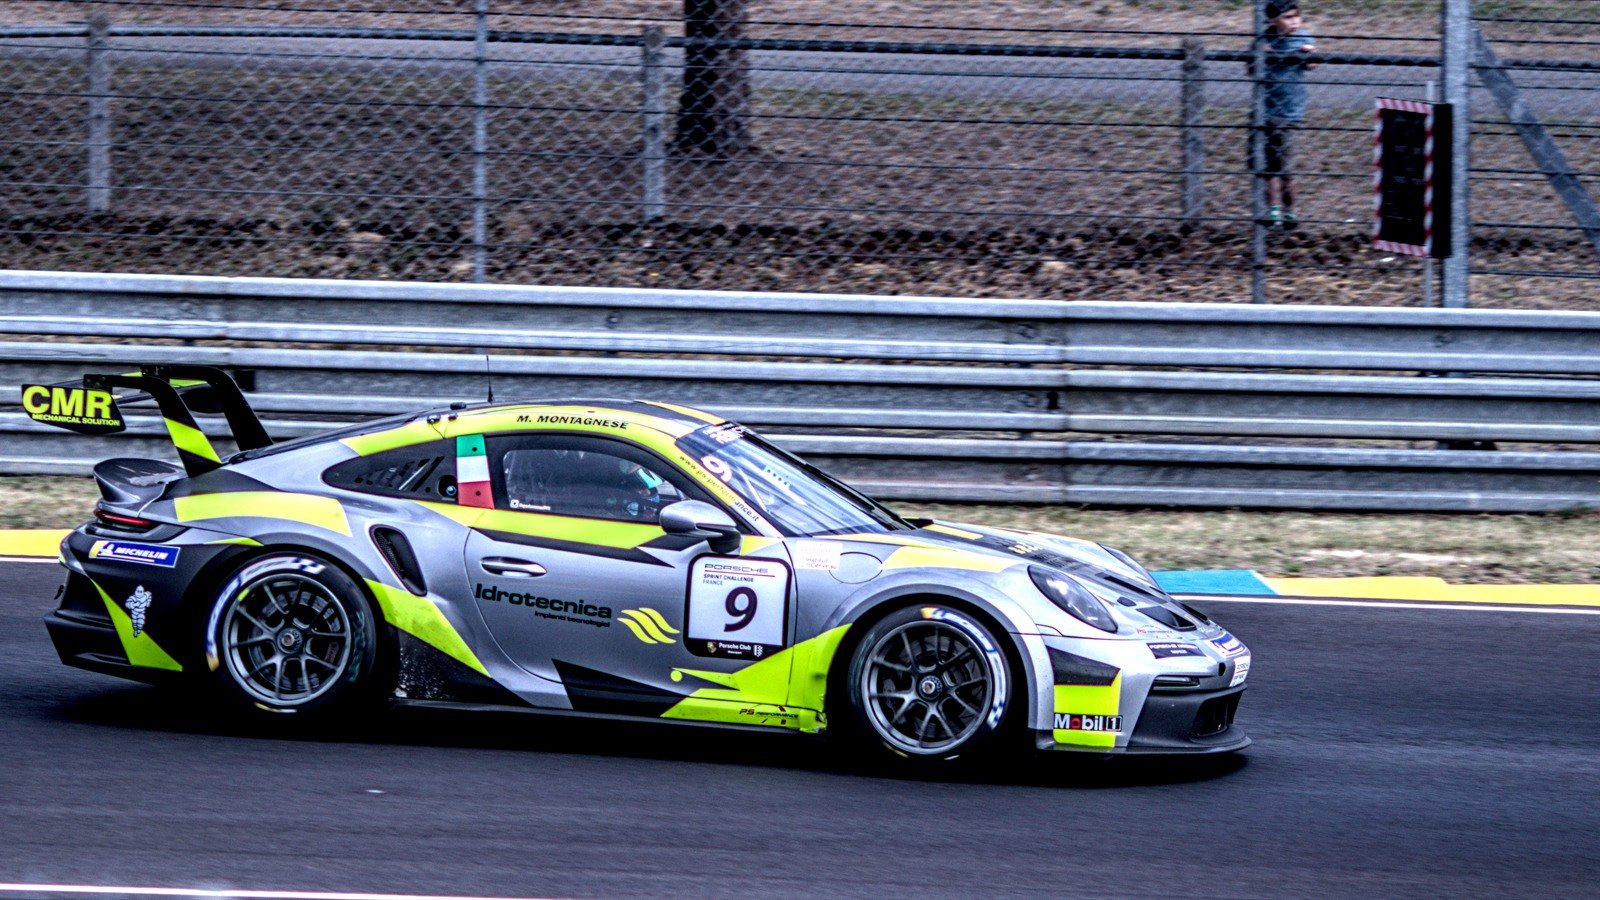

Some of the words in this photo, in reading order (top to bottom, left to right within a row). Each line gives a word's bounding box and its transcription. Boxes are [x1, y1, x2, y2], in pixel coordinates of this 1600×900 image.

[22, 385, 112, 419] CMR
[32, 413, 82, 424] MECHANICAL
[82, 417, 120, 426] SOLUTION
[516, 415, 532, 423] M.
[537, 415, 630, 430] MONTAGNESE
[114, 546, 168, 560] MICHELIN
[704, 563, 769, 574] PORSCHE
[723, 574, 754, 583] CHALLENGE
[475, 583, 612, 619] Idrotecnica
[724, 586, 758, 632] 9
[718, 642, 739, 650] Porsche
[740, 643, 752, 651] Club
[1054, 713, 1103, 730] Mobil
